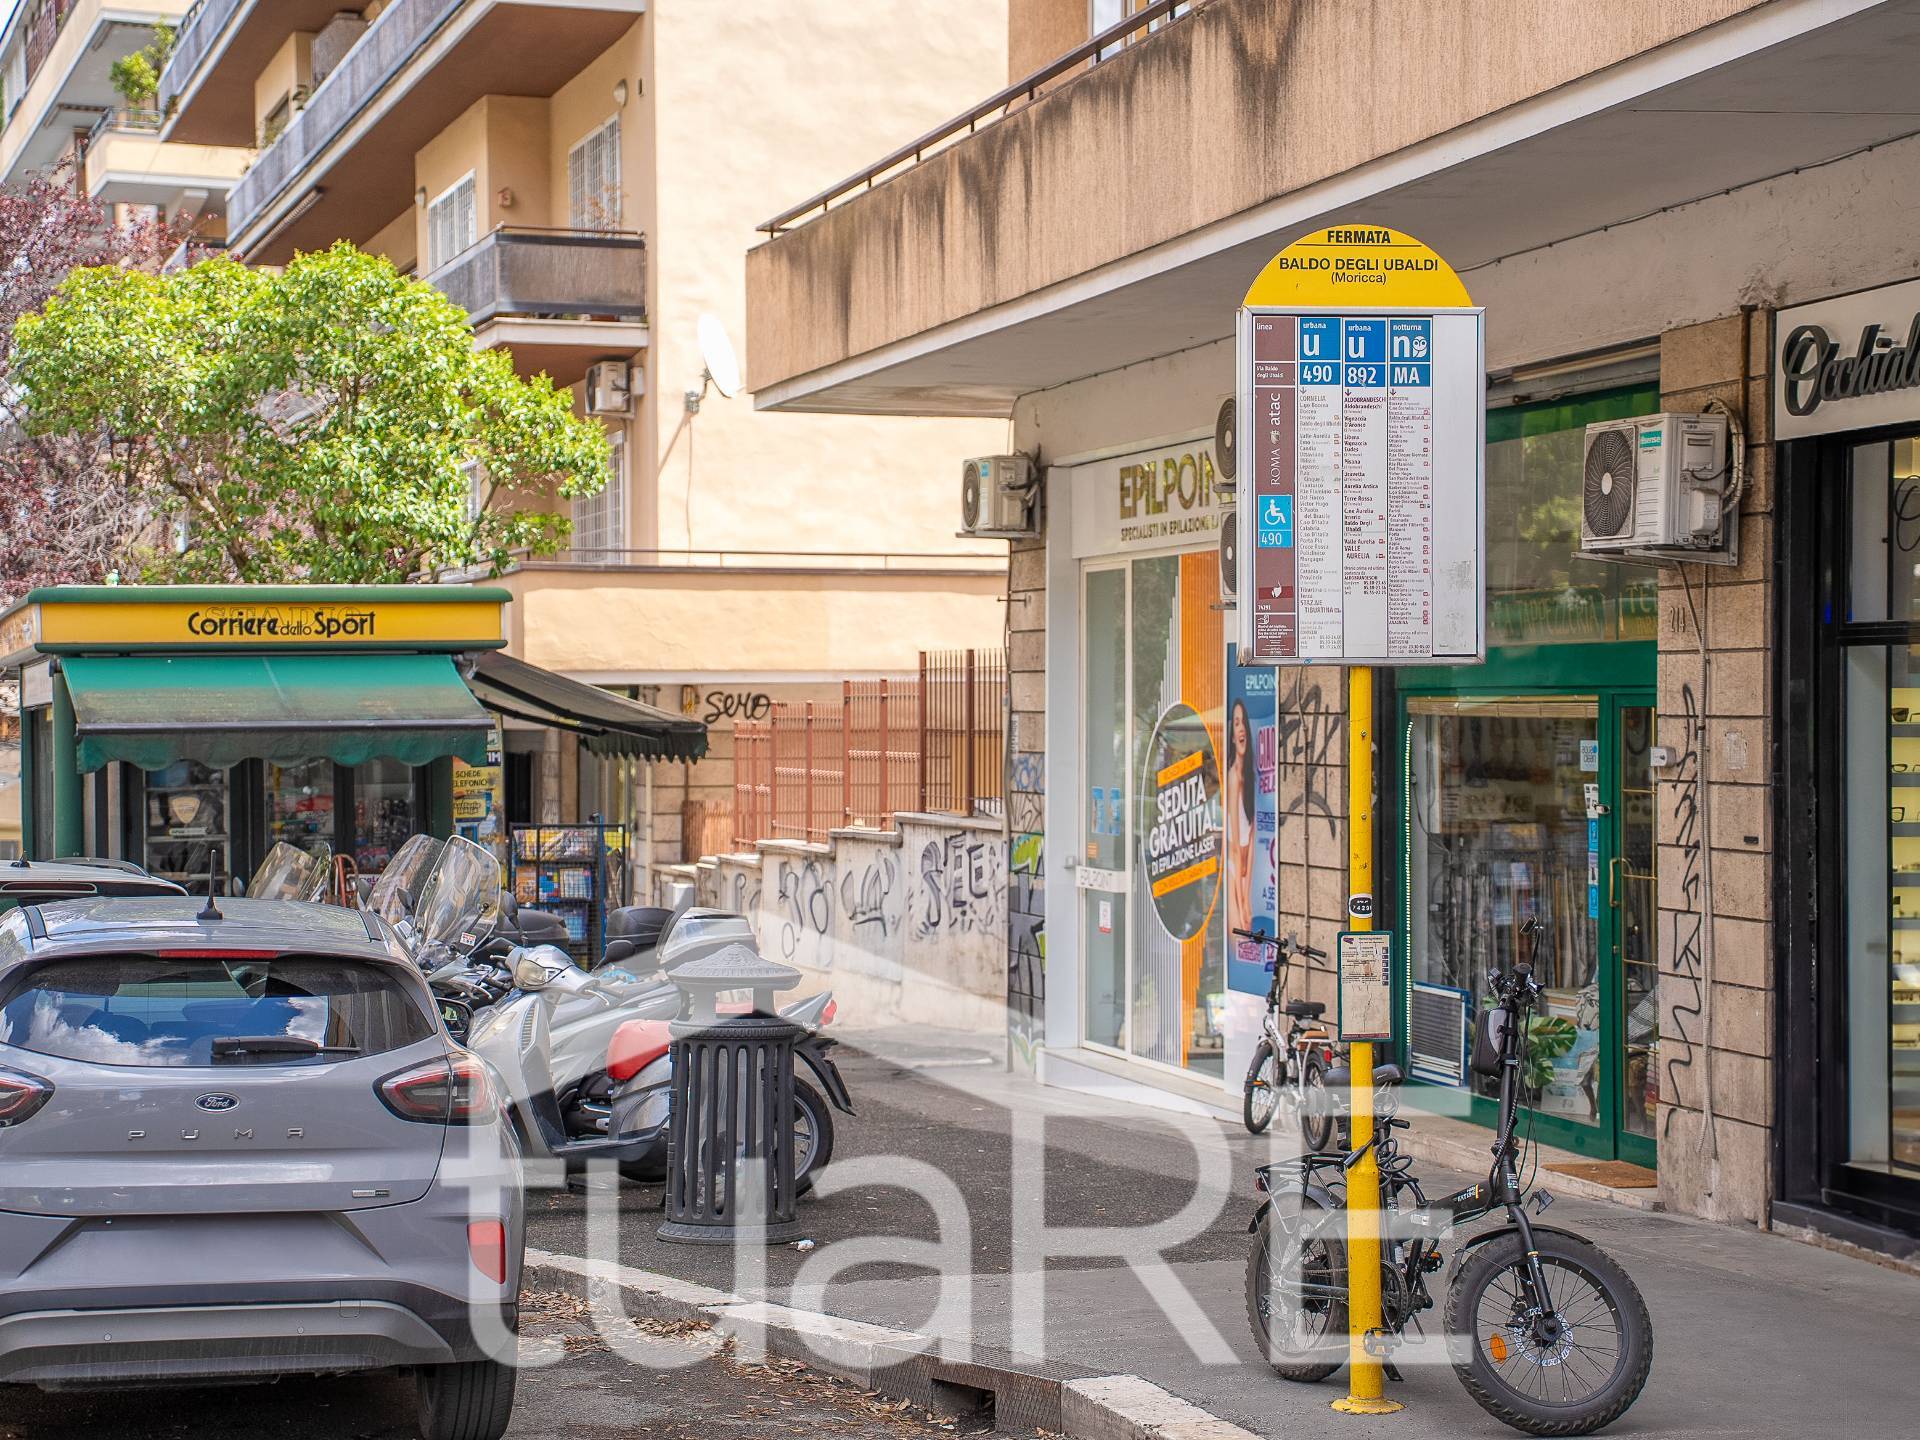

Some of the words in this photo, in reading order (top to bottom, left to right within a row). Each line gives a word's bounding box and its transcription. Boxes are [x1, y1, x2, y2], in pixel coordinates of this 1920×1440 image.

[1327, 230, 1391, 244] FERMATA
[1279, 257, 1330, 270] BALDO
[1335, 258, 1379, 271] DEGLI
[1383, 258, 1439, 271] UBALDI
[1330, 272, 1387, 285] (Moricca)
[1256, 322, 1273, 330] linea
[1302, 321, 1327, 329] urbana
[1348, 324, 1372, 332] urbana
[1392, 323, 1422, 331] notturna
[1303, 334, 1320, 356] u
[1348, 336, 1365, 359] u
[1302, 365, 1333, 382] 490
[1347, 366, 1377, 384] 892
[1393, 366, 1420, 384] MA
[1269, 392, 1281, 426] atac
[1270, 447, 1281, 485] ROMA
[1120, 521, 1159, 542] SPECIALISTI
[1160, 520, 1167, 536] IN
[1169, 515, 1210, 535] EPILAZIONE
[1260, 533, 1282, 545] 490
[188, 611, 280, 636] Corriere
[279, 620, 313, 636] dello
[314, 611, 376, 639] Sport
[455, 769, 481, 778] SCHEDE
[1157, 773, 1207, 824] SEDUTA
[1150, 799, 1217, 859] GRATUITA!
[1159, 843, 1195, 873] EPILAZIONE
[1194, 835, 1216, 858] LASER
[204, 1096, 230, 1109] Ford
[127, 1127, 305, 1141] PUMA
